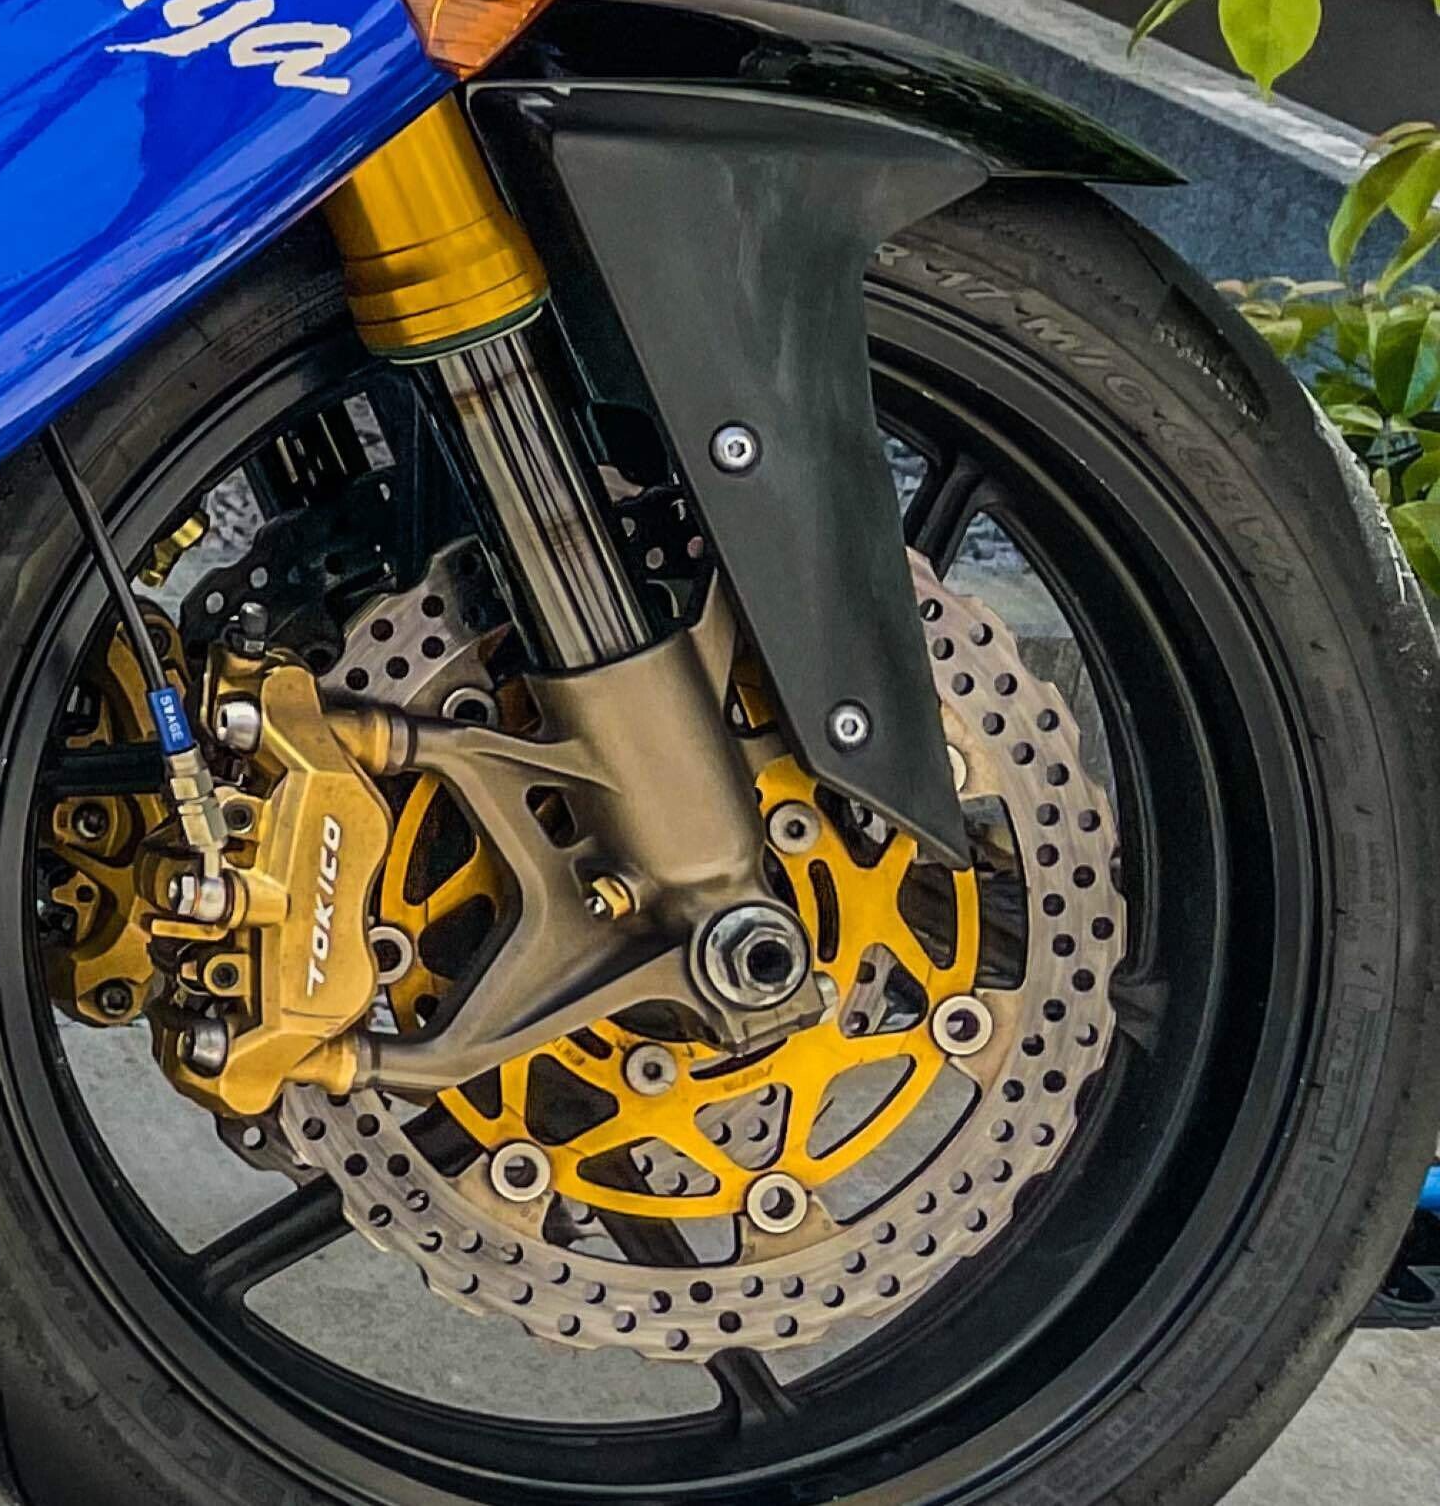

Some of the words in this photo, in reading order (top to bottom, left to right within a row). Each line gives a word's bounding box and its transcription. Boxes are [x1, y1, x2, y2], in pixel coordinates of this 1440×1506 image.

[934, 267, 1018, 301] 17
[159, 694, 184, 743] SWAGE
[306, 815, 342, 998] TOKICO
